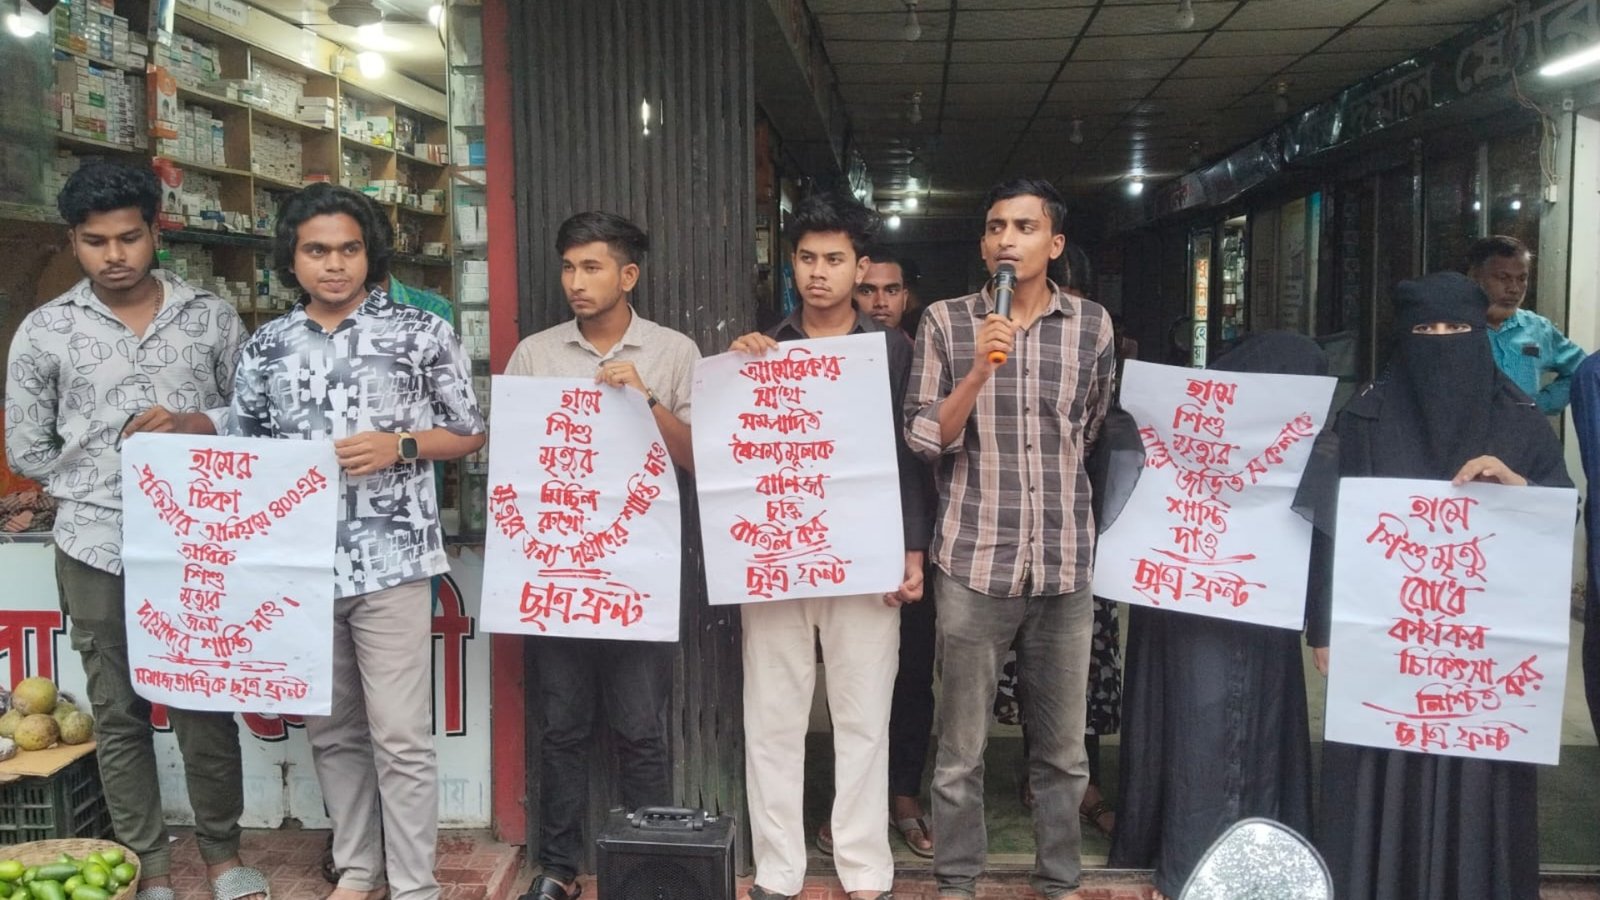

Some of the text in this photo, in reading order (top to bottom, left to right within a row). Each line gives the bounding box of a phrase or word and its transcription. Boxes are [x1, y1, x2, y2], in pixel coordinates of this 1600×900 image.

[739, 348, 845, 384] আমেরিকার
[561, 387, 602, 416] হামে
[1187, 378, 1237, 413] হামে
[546, 413, 592, 444] শিশু
[1173, 403, 1225, 438] শিশু
[189, 449, 258, 479] হামের
[539, 446, 599, 479] মৃত্যুর
[1173, 433, 1241, 469] মৃত্যুর
[188, 479, 241, 513] টিকা
[540, 480, 600, 513] মিছিল
[756, 467, 830, 499] বাণিজ্য
[523, 535, 565, 568] জন্য
[620, 473, 660, 521] শাস্তি
[644, 441, 666, 477] দাও
[767, 496, 804, 526] চুক্তি
[1167, 496, 1231, 533] শাস্তি
[1409, 495, 1478, 534] হামে
[730, 510, 829, 551] বাতিল কর
[1169, 526, 1218, 559] দাও
[1366, 513, 1496, 582] শিশু মৃত্যু
[178, 543, 236, 565] অধিক
[184, 564, 224, 589] শিশু
[746, 554, 852, 598] ছাত্র ফ্রন্ট
[1129, 558, 1266, 607] ছাত্র ফ্রন্ট
[180, 587, 226, 613] মৃত্যুর
[520, 581, 650, 632] ছাত্র ফ্রন্ট
[1400, 576, 1485, 616] রোধে
[178, 612, 222, 632] জন্য
[1388, 616, 1491, 650] কার্যকর
[201, 625, 252, 658] শাস্তি
[1394, 647, 1498, 685] চিকিৎসা
[231, 678, 261, 703] ছাত্র
[265, 675, 308, 701] ফ্রন্ট
[1416, 655, 1544, 714] নিশ্চিত কর
[1385, 720, 1528, 752] ছাত্র ফ্রন্ট
